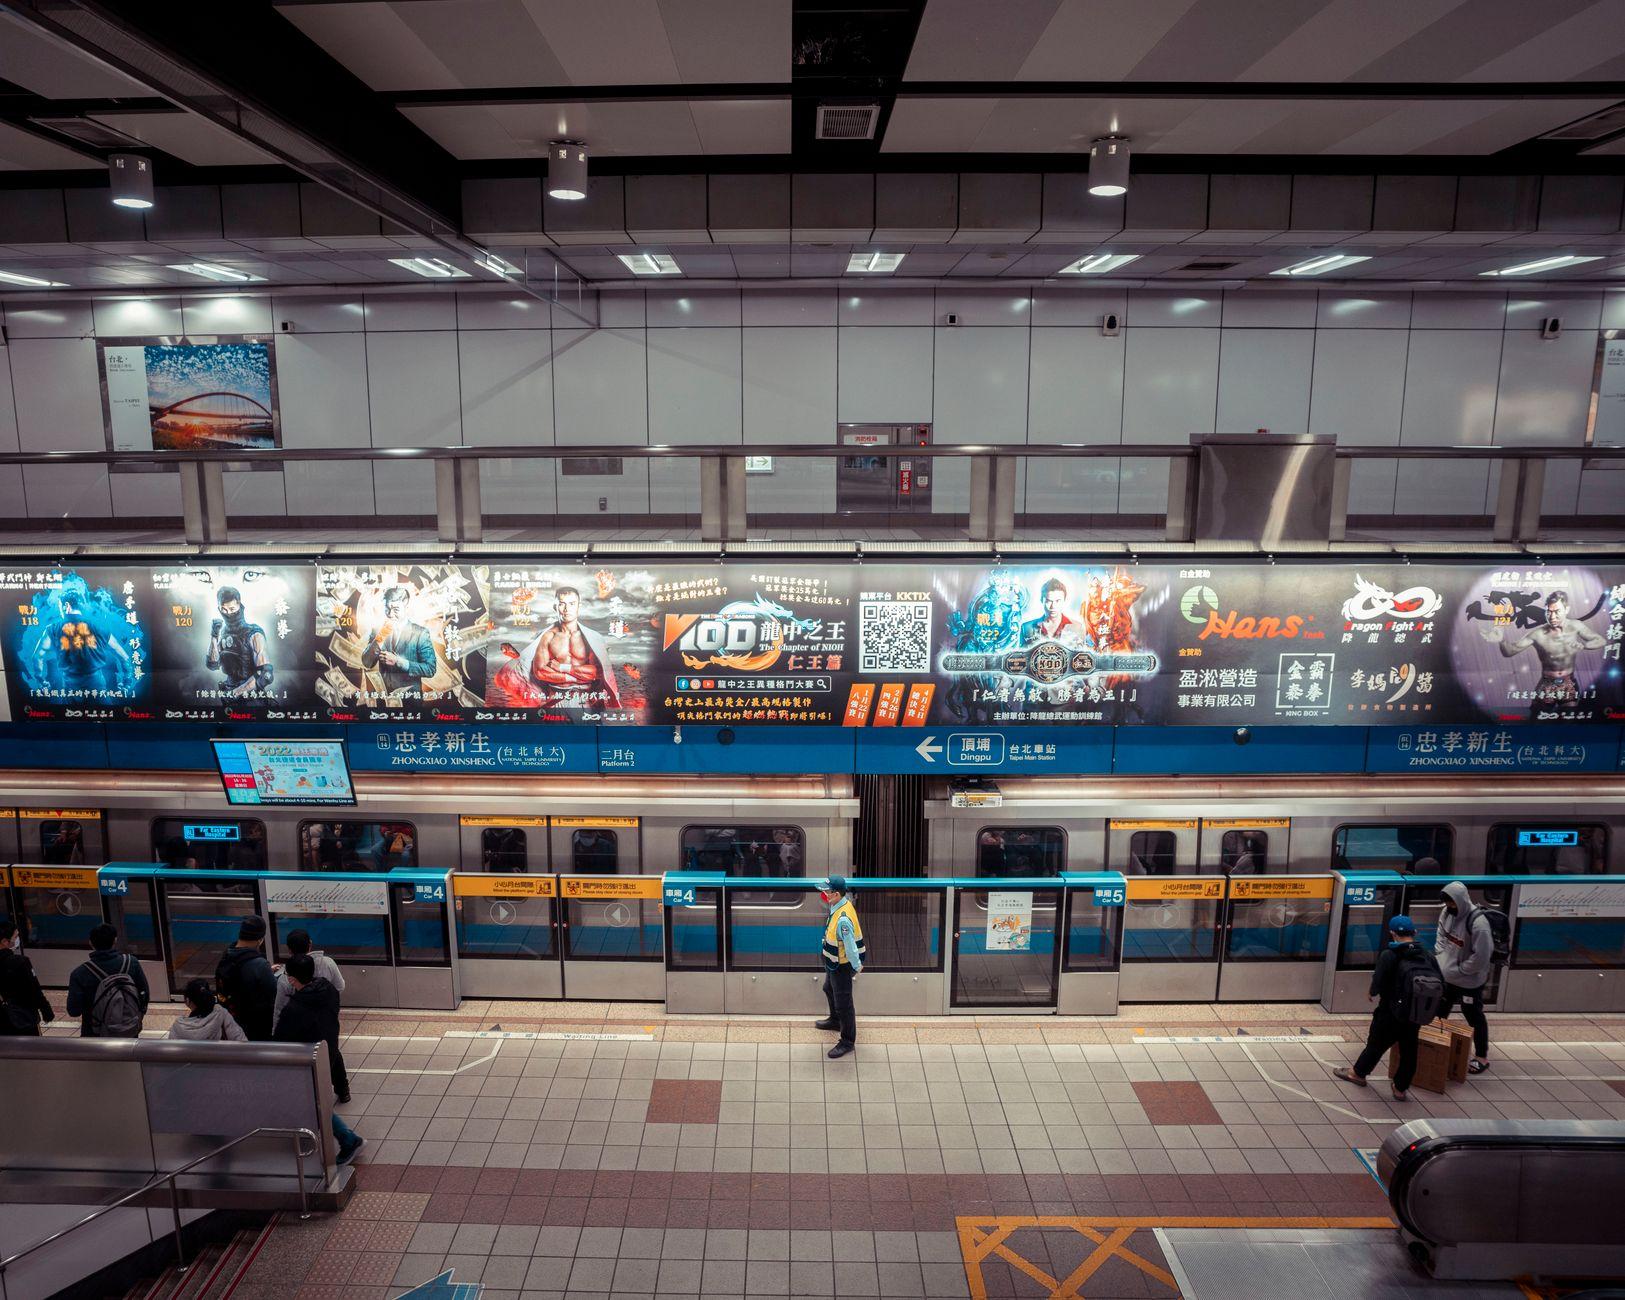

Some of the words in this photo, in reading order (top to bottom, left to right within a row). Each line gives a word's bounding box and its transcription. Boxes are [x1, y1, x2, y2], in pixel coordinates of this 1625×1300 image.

[896, 592, 931, 601] KKTIX
[21, 616, 39, 627] 118
[175, 617, 193, 627] 120
[1198, 610, 1304, 641] Hans
[1343, 621, 1383, 632] Dragon
[1385, 621, 1414, 632] Fight
[1416, 621, 1434, 631] Art
[760, 621, 846, 642] 龍中之王
[759, 643, 775, 651] The
[778, 643, 808, 653] Chapter
[811, 643, 821, 651] of
[822, 643, 844, 651] NIOH
[788, 655, 843, 671] 仁王篇
[1178, 668, 1258, 688] 盈淞營造
[1177, 694, 1256, 707] 事業有限公司
[395, 731, 492, 753] 忠孝新生
[961, 737, 991, 752] 頂埔
[1009, 743, 1057, 754] 台北車站
[1415, 731, 1513, 753] 忠孝新生
[392, 756, 448, 765] ZHONGXIAO
[450, 756, 497, 766] XINSHENG
[601, 749, 635, 761] 二月台
[960, 753, 992, 763] Dingpu
[1409, 757, 1467, 766] ZHONGXIAO
[1469, 757, 1515, 766] XINSHENG
[117, 880, 128, 893] 4
[433, 886, 444, 899] 4
[683, 889, 694, 903] 4
[1112, 889, 1124, 903] 5
[1363, 888, 1374, 902] 5
